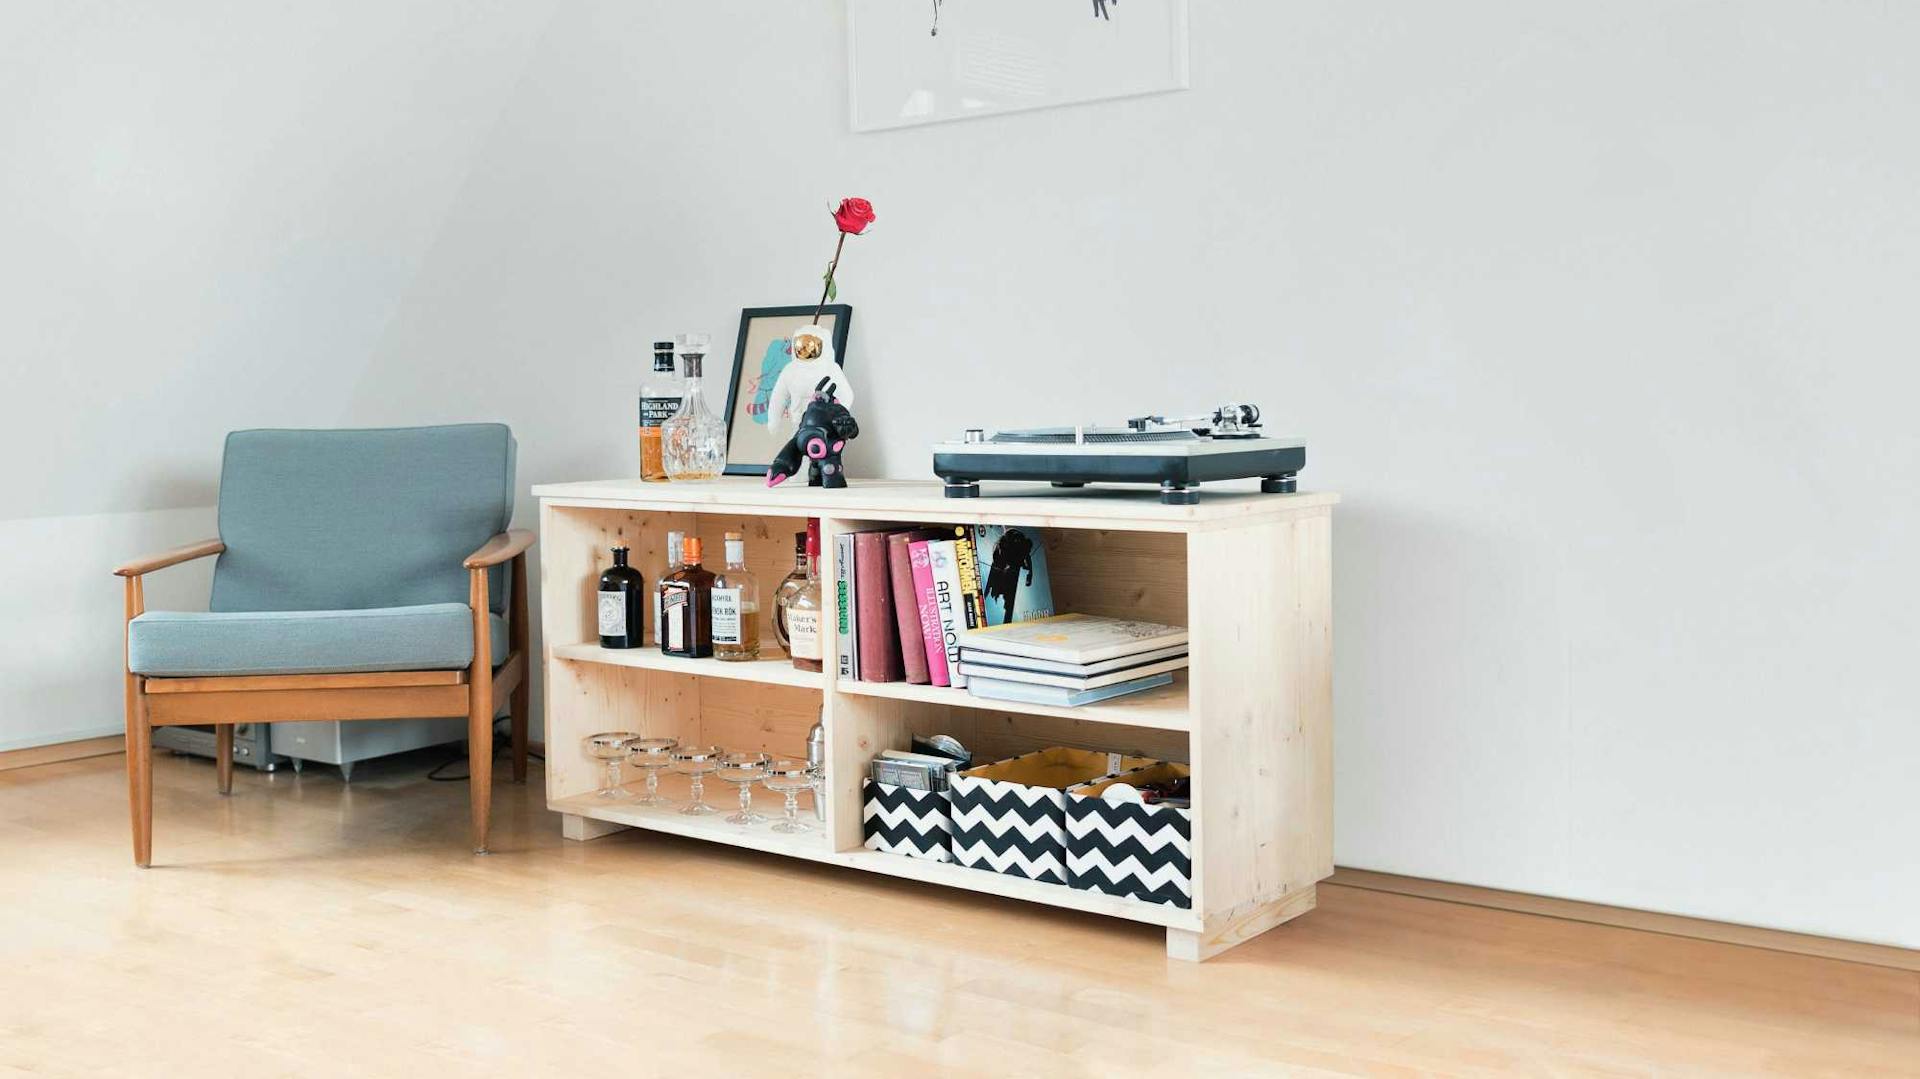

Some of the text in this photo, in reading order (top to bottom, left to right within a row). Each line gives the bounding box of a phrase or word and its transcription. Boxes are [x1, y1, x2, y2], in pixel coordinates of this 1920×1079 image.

[641, 401, 679, 411] HIGHLAND
[648, 410, 668, 419] PARK
[936, 581, 952, 613] ART
[943, 619, 960, 664] NOW
